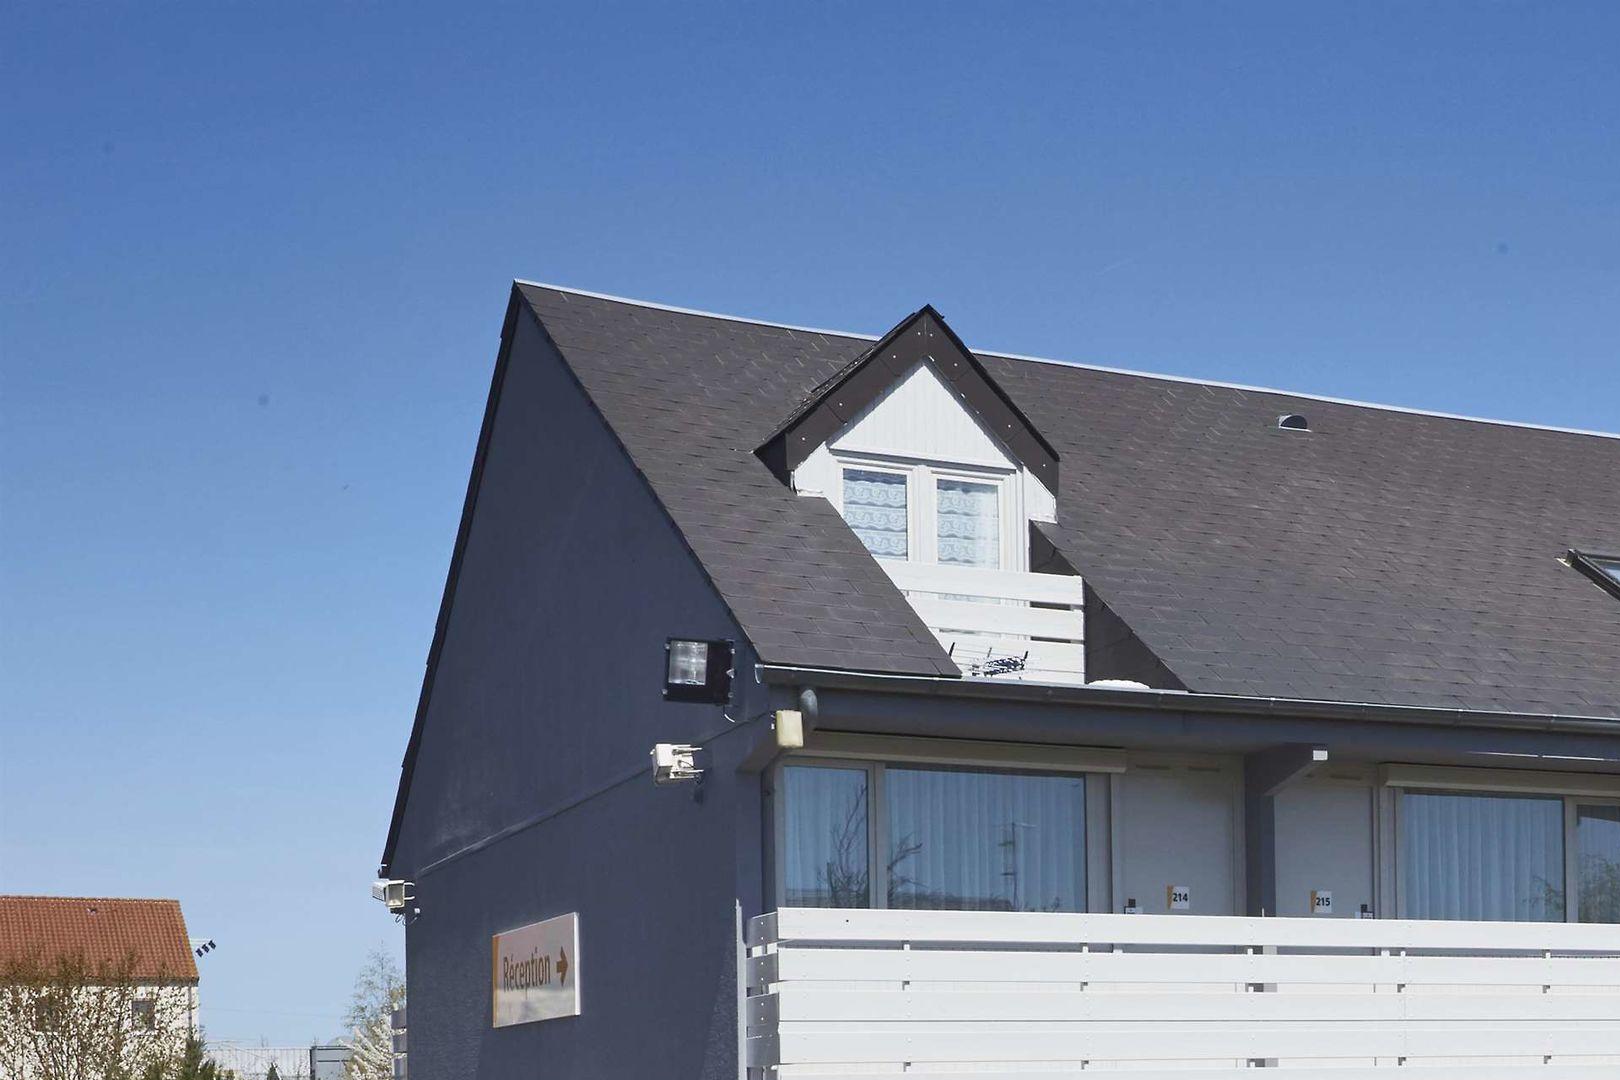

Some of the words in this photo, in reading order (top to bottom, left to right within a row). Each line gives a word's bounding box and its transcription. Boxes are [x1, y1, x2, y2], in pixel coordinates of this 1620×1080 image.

[1172, 893, 1188, 902] 214
[1315, 897, 1331, 906] 215
[503, 946, 551, 1000] Réception
